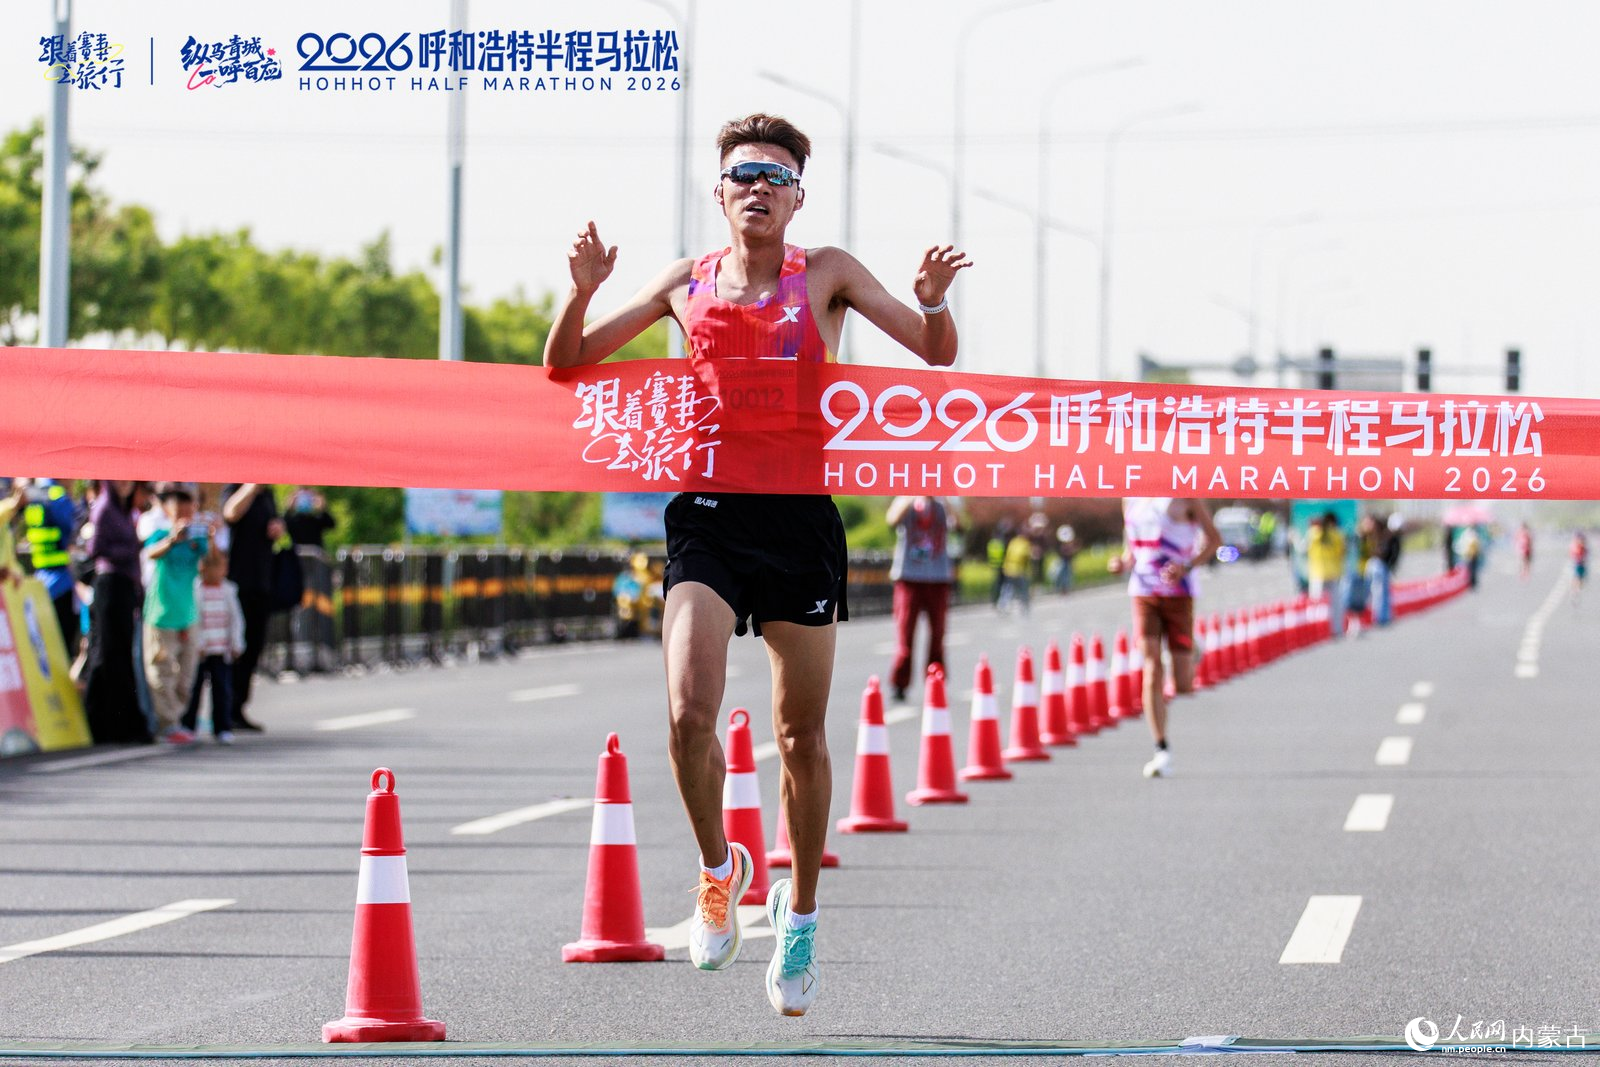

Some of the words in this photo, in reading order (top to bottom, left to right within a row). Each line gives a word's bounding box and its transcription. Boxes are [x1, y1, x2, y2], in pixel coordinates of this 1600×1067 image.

[824, 461, 1005, 489] HOHHOT
[1033, 463, 1142, 490] HALF
[1171, 465, 1416, 492] MARATHON
[1444, 466, 1546, 493] 2026
